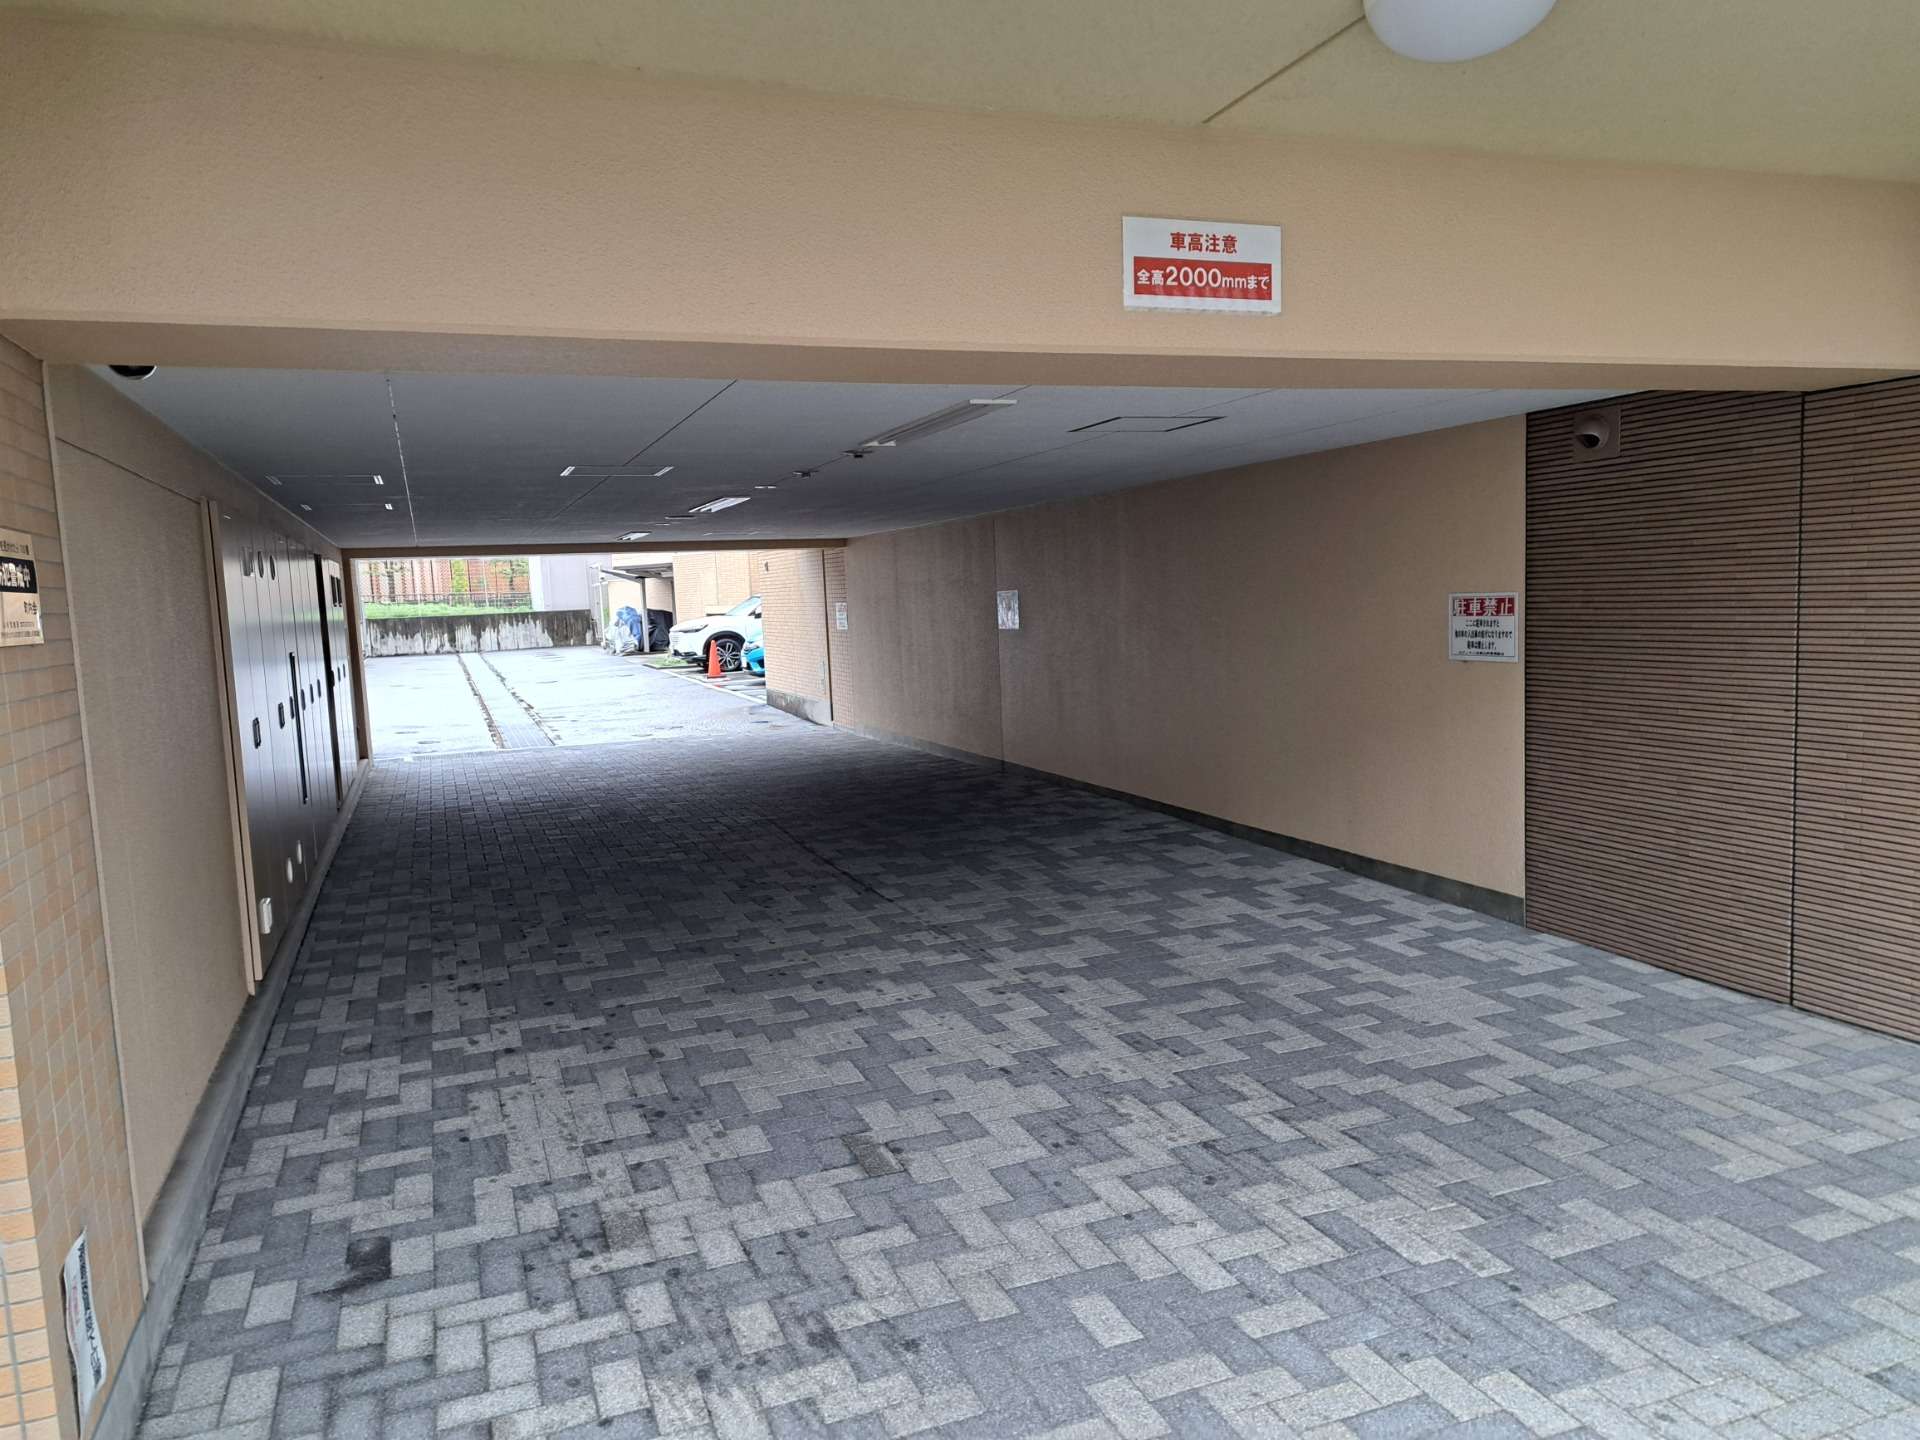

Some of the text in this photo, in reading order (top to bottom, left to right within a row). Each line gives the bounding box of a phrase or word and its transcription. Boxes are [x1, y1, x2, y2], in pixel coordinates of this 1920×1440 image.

[1170, 231, 1238, 254] 車高注意
[1136, 265, 1270, 290] 全高2000mmまで
[0, 561, 31, 589] 犯警戒中
[1453, 597, 1514, 616] 駐車禁止
